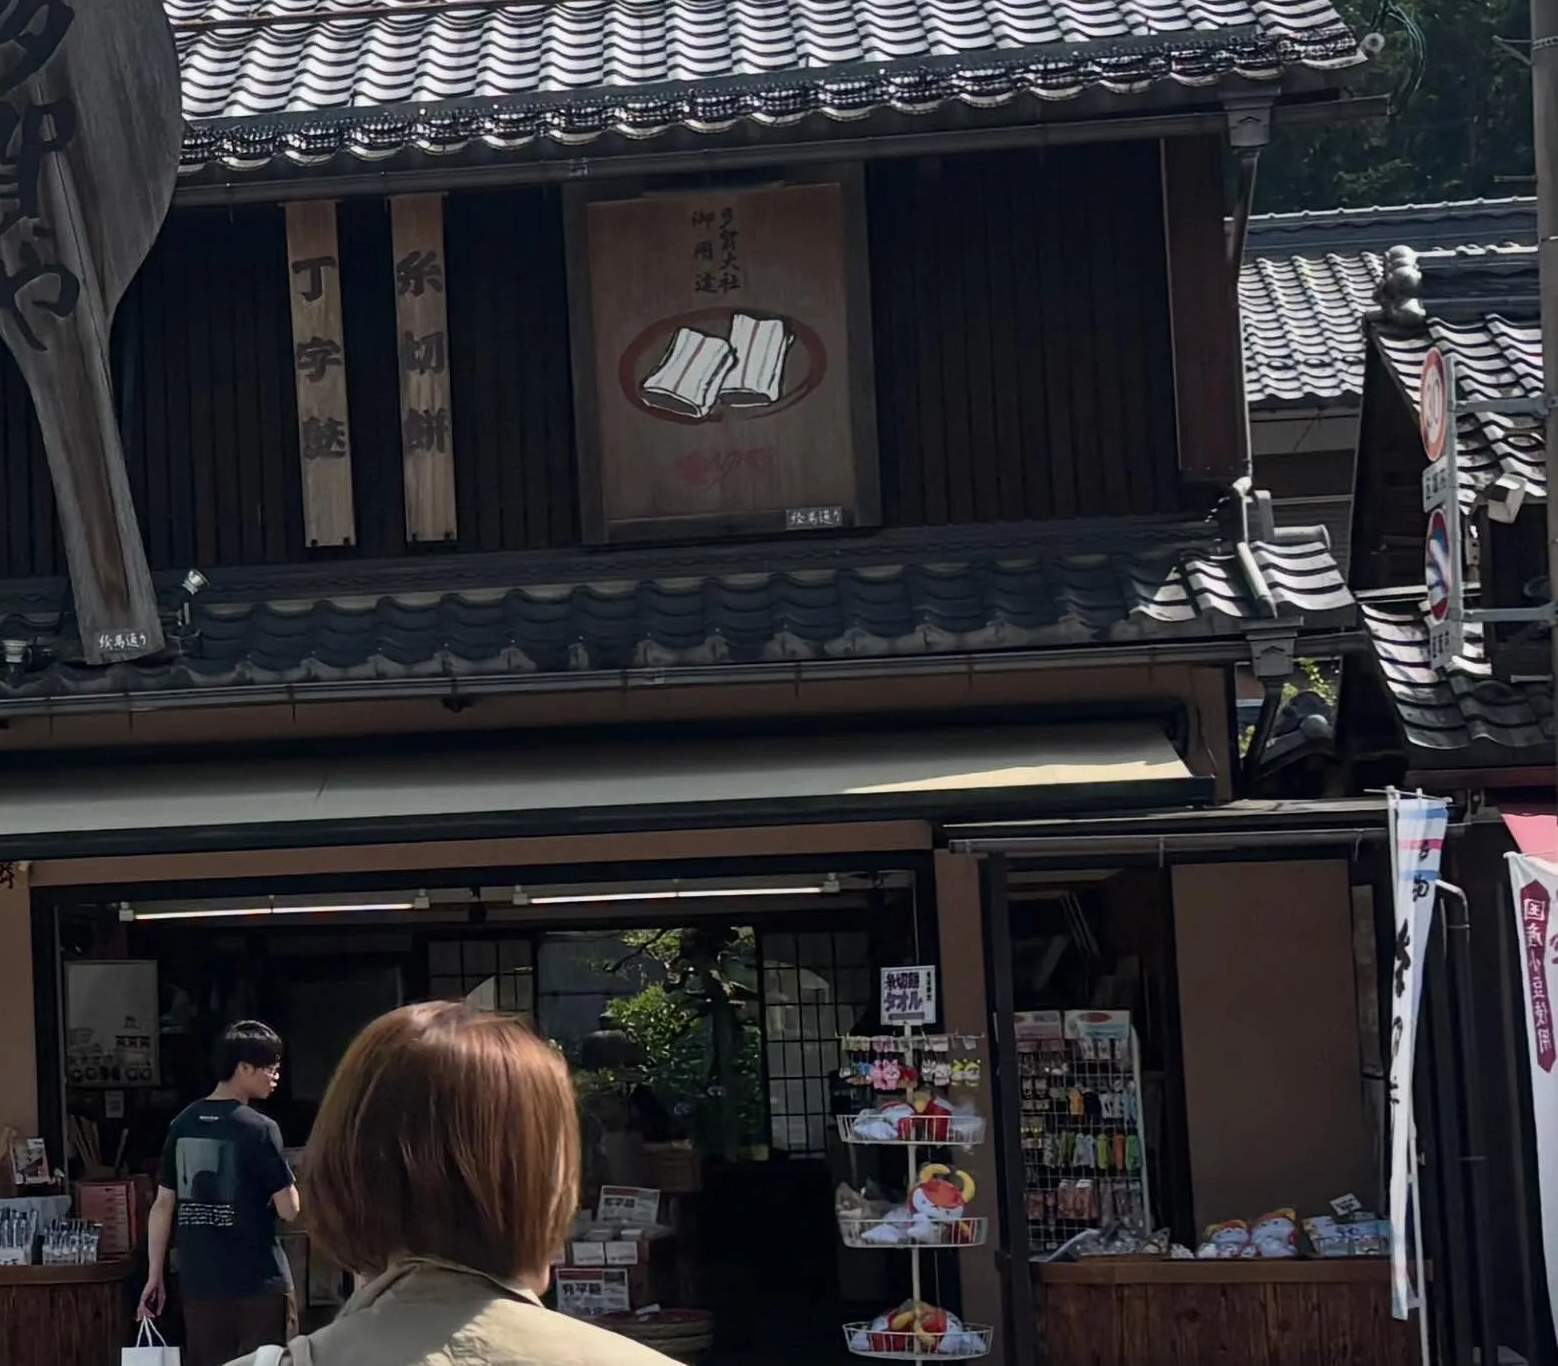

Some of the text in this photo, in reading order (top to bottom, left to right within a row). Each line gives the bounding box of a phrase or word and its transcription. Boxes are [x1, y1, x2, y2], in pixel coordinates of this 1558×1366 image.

[396, 251, 448, 455] 糸切餅
[883, 991, 923, 1012] タオル
